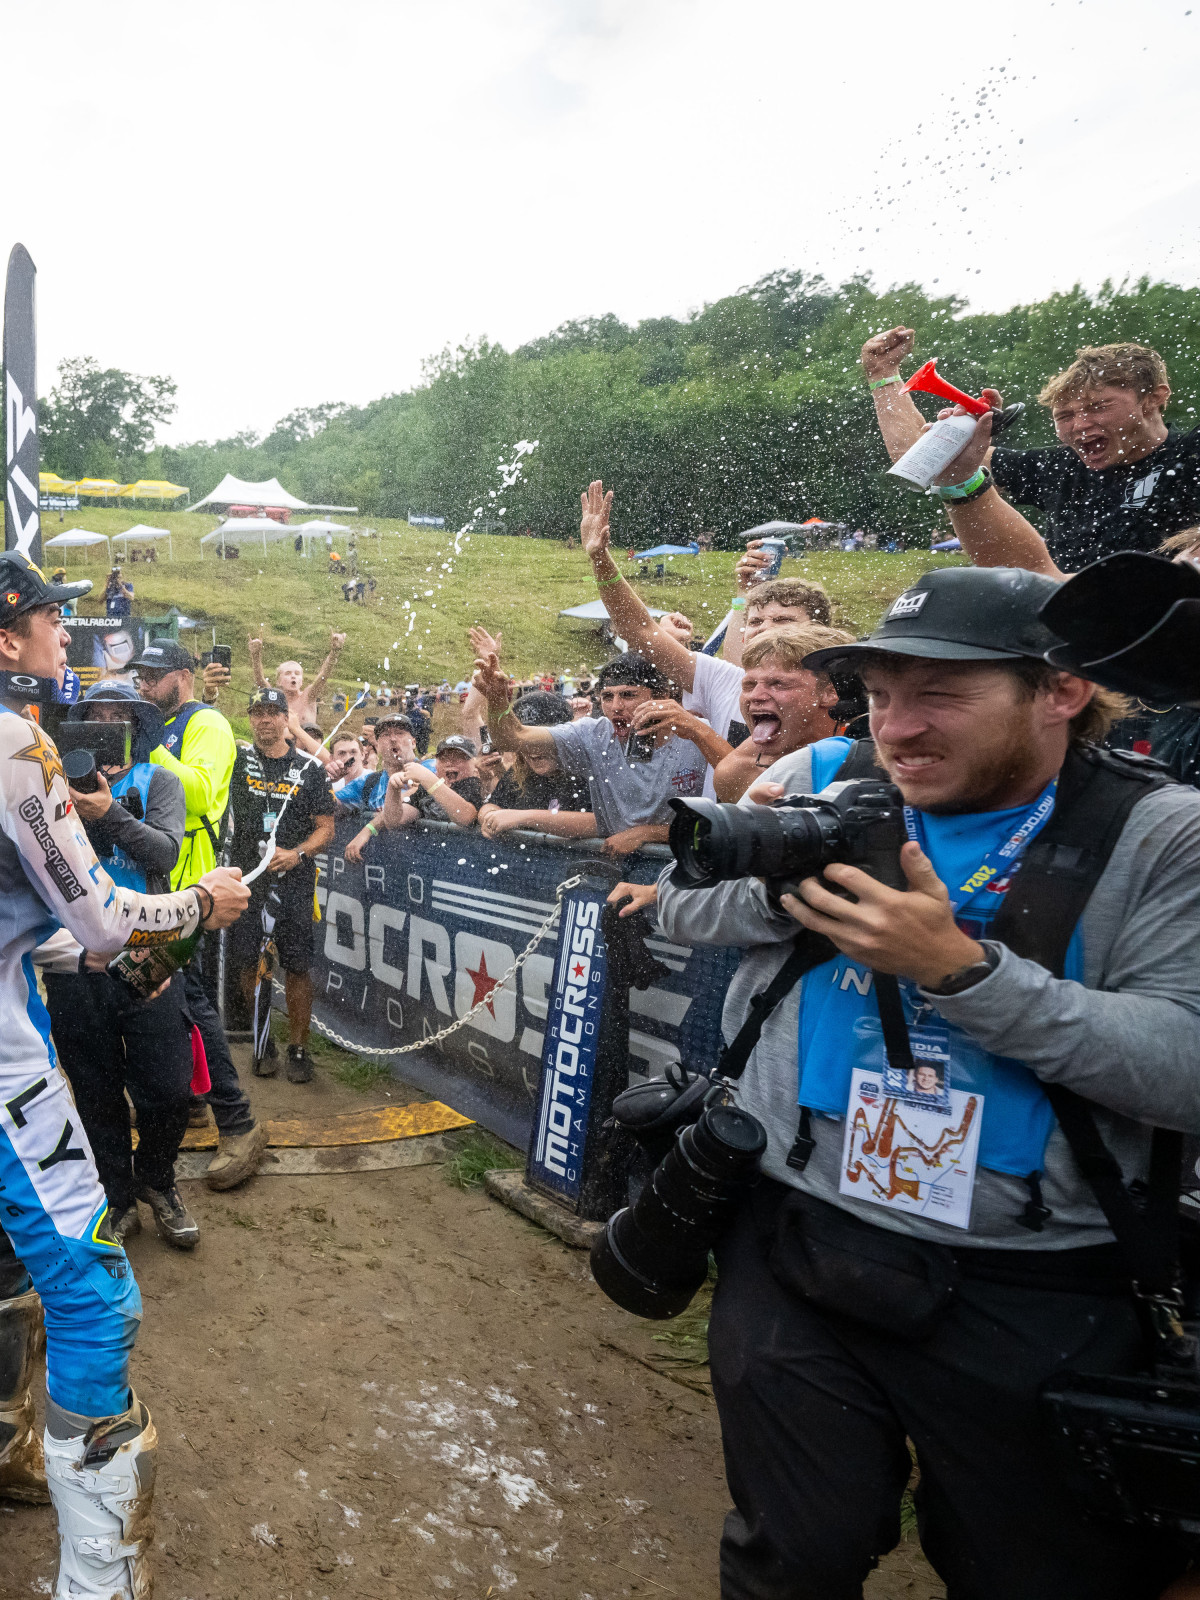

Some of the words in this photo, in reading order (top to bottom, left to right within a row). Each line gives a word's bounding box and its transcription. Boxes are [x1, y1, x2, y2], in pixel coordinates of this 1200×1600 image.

[7, 684, 28, 694] FACTORY
[28, 686, 40, 695] PILOT
[31, 817, 83, 899] Husqvarna
[998, 795, 1054, 858] MOTOCROSS
[332, 856, 424, 905] PRO
[959, 864, 997, 893] 2024
[121, 902, 197, 924] RACING
[544, 900, 599, 1177] MOTOCROSS
[547, 997, 562, 1066] PRO
[566, 904, 606, 1182] CHAMPIONSH
[4, 1077, 88, 1172] LY
